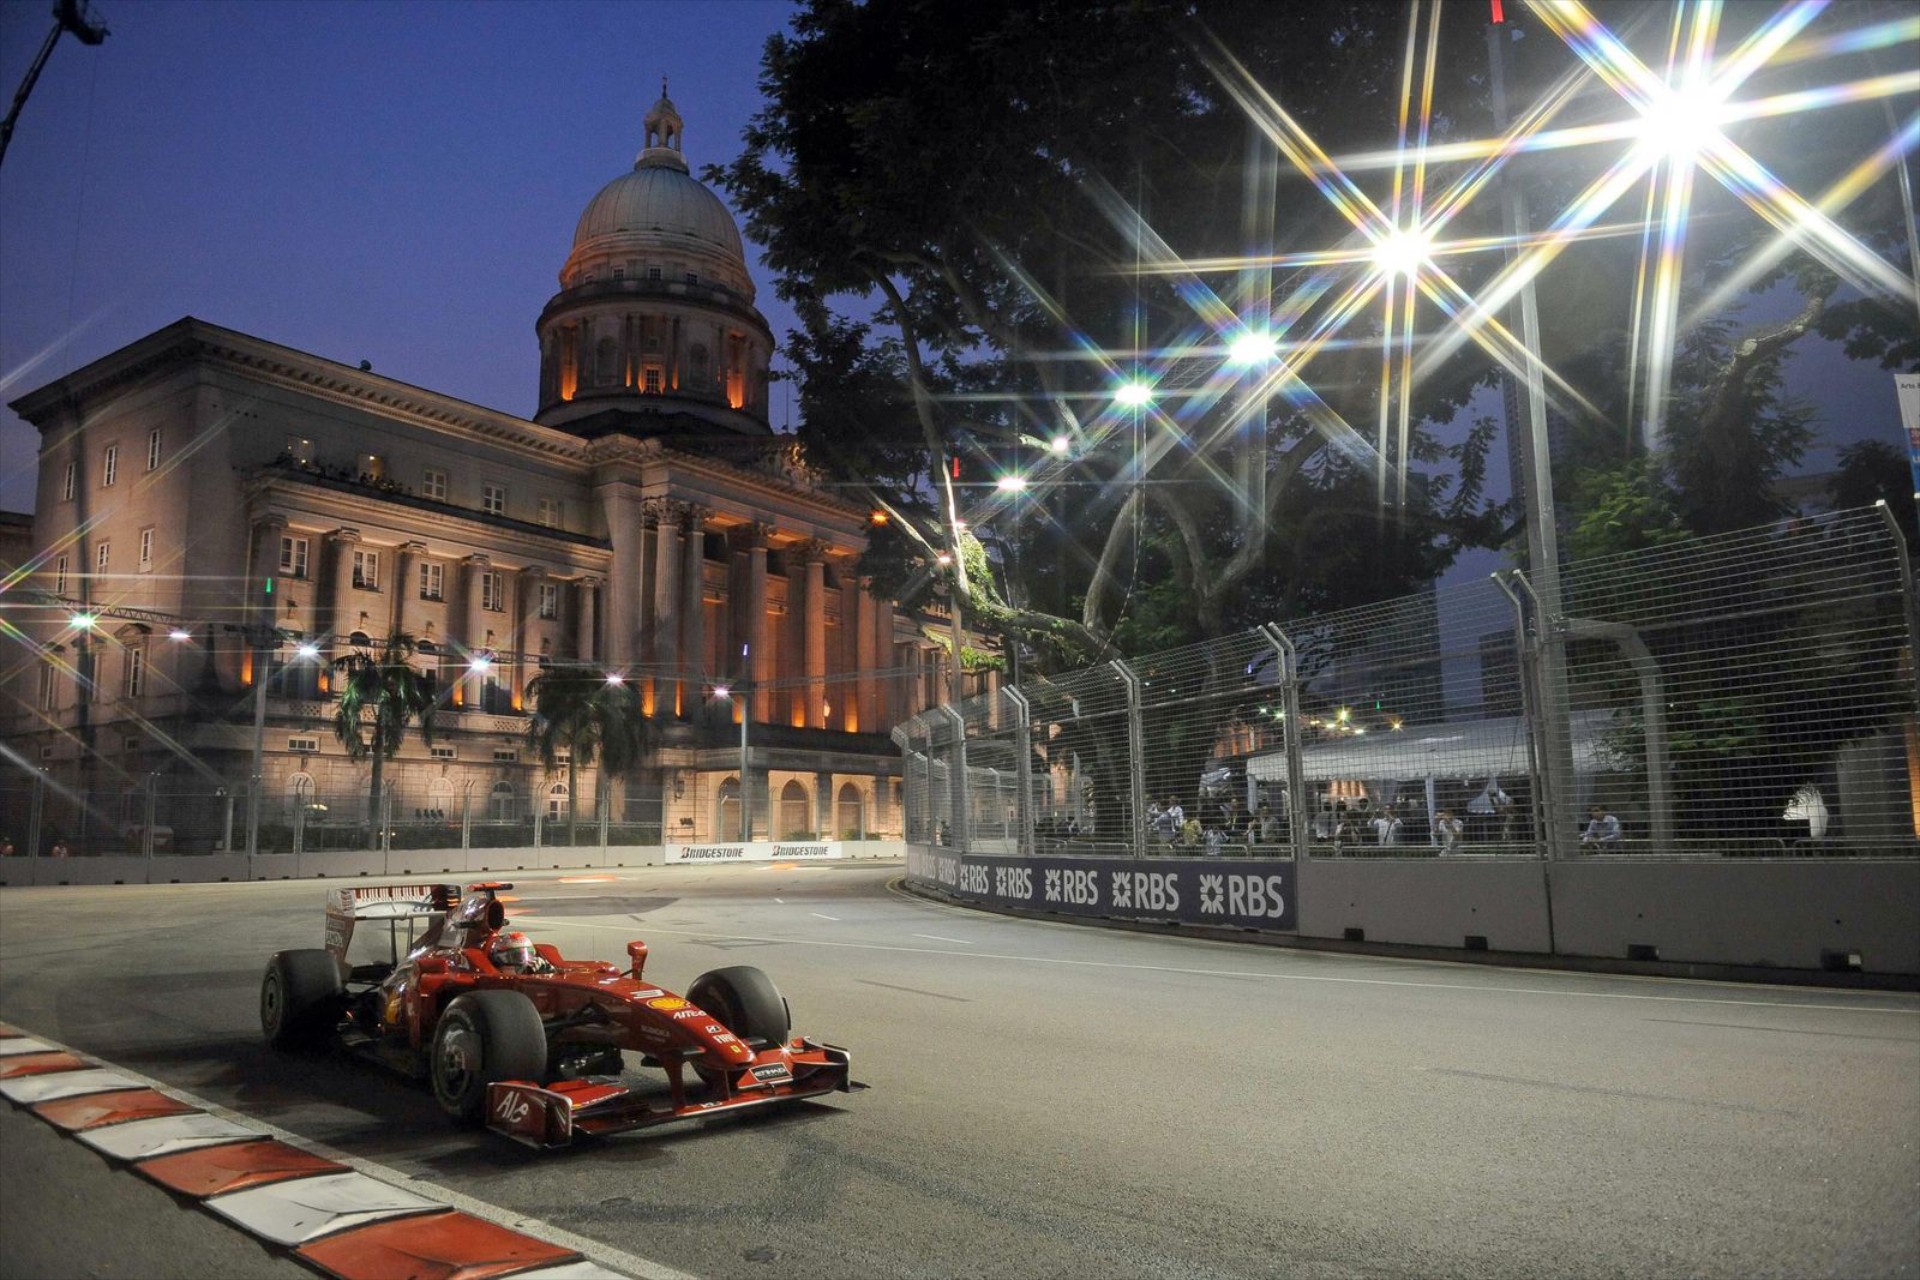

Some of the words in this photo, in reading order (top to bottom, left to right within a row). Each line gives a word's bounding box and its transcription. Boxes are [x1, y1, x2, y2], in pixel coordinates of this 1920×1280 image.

[681, 847, 744, 858] BRIDGESTONE
[772, 845, 828, 857] BRIDGESTONE
[969, 864, 989, 895] RBS
[1007, 866, 1033, 900] RBS
[1063, 870, 1099, 905] RBS
[1135, 873, 1180, 912] RBS
[1229, 875, 1284, 919] RBS
